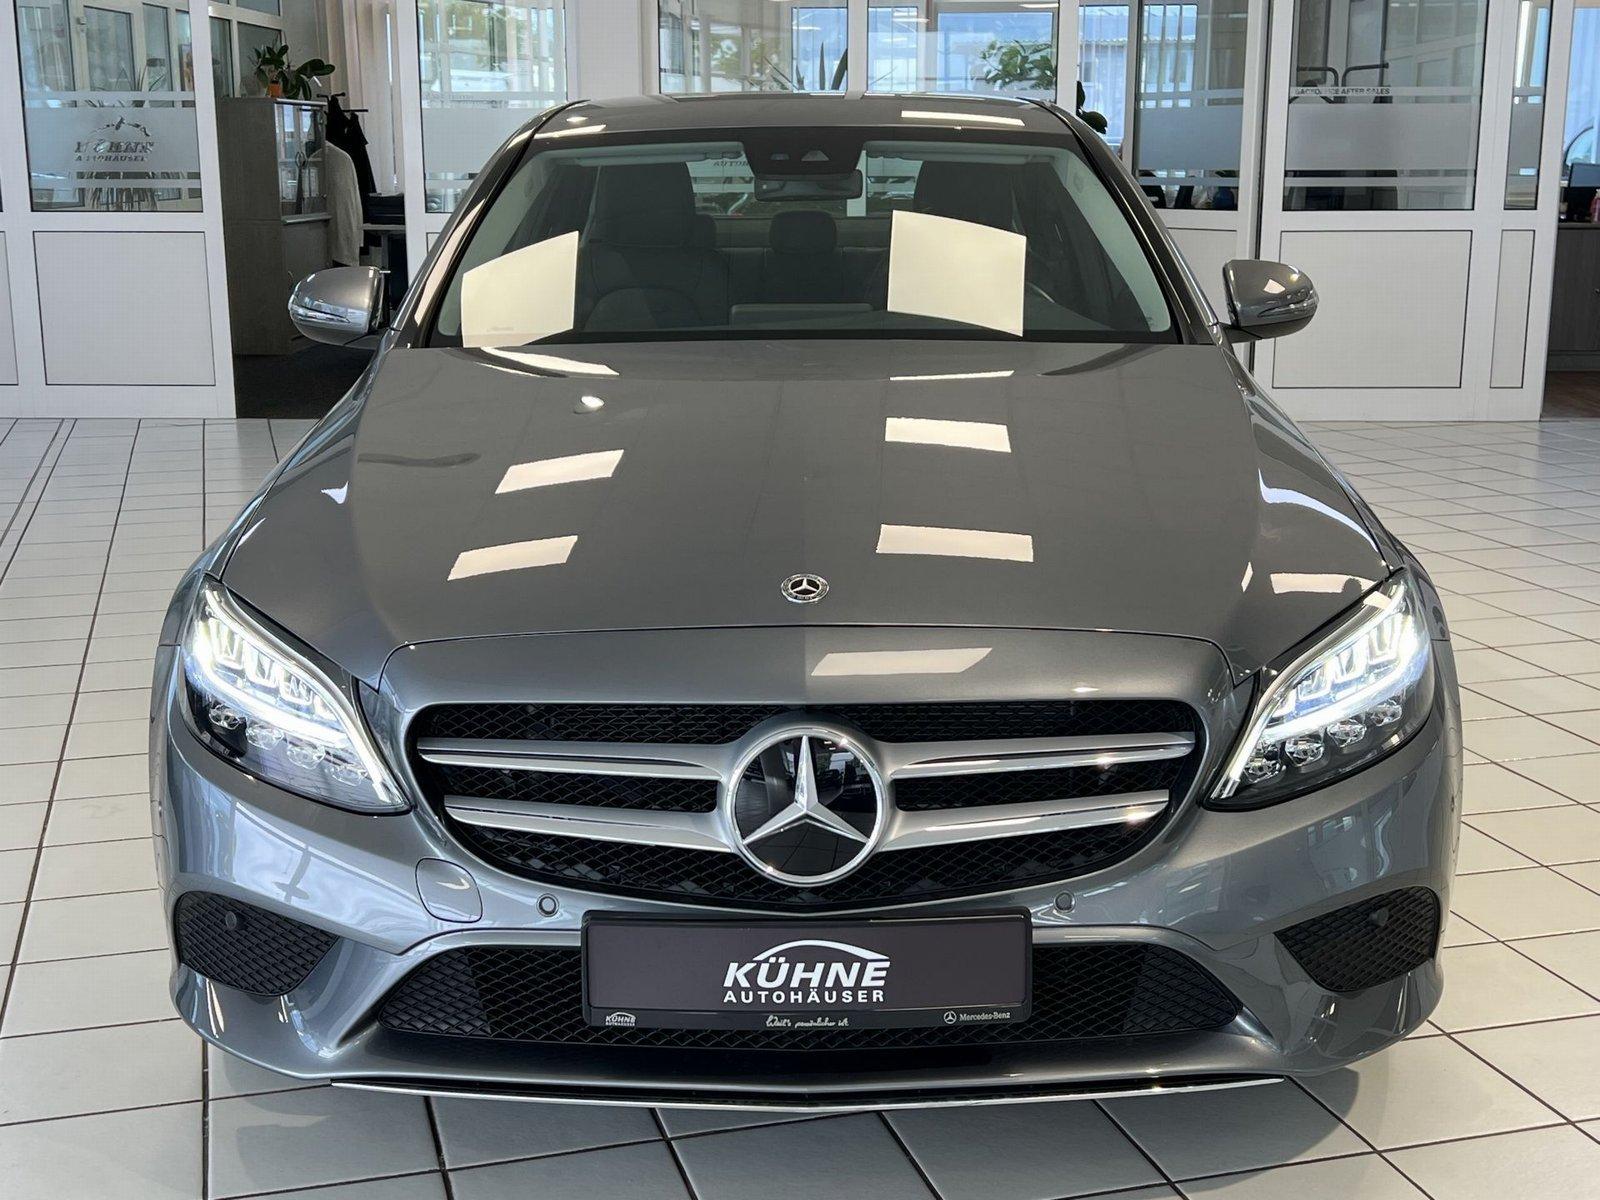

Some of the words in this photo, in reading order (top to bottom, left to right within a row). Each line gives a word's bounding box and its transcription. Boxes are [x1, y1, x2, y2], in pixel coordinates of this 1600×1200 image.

[723, 956, 891, 989] KÜHNE
[723, 988, 885, 1004] AUTOHÄUSER
[959, 1011, 1011, 1021] Mercedes-Benz
